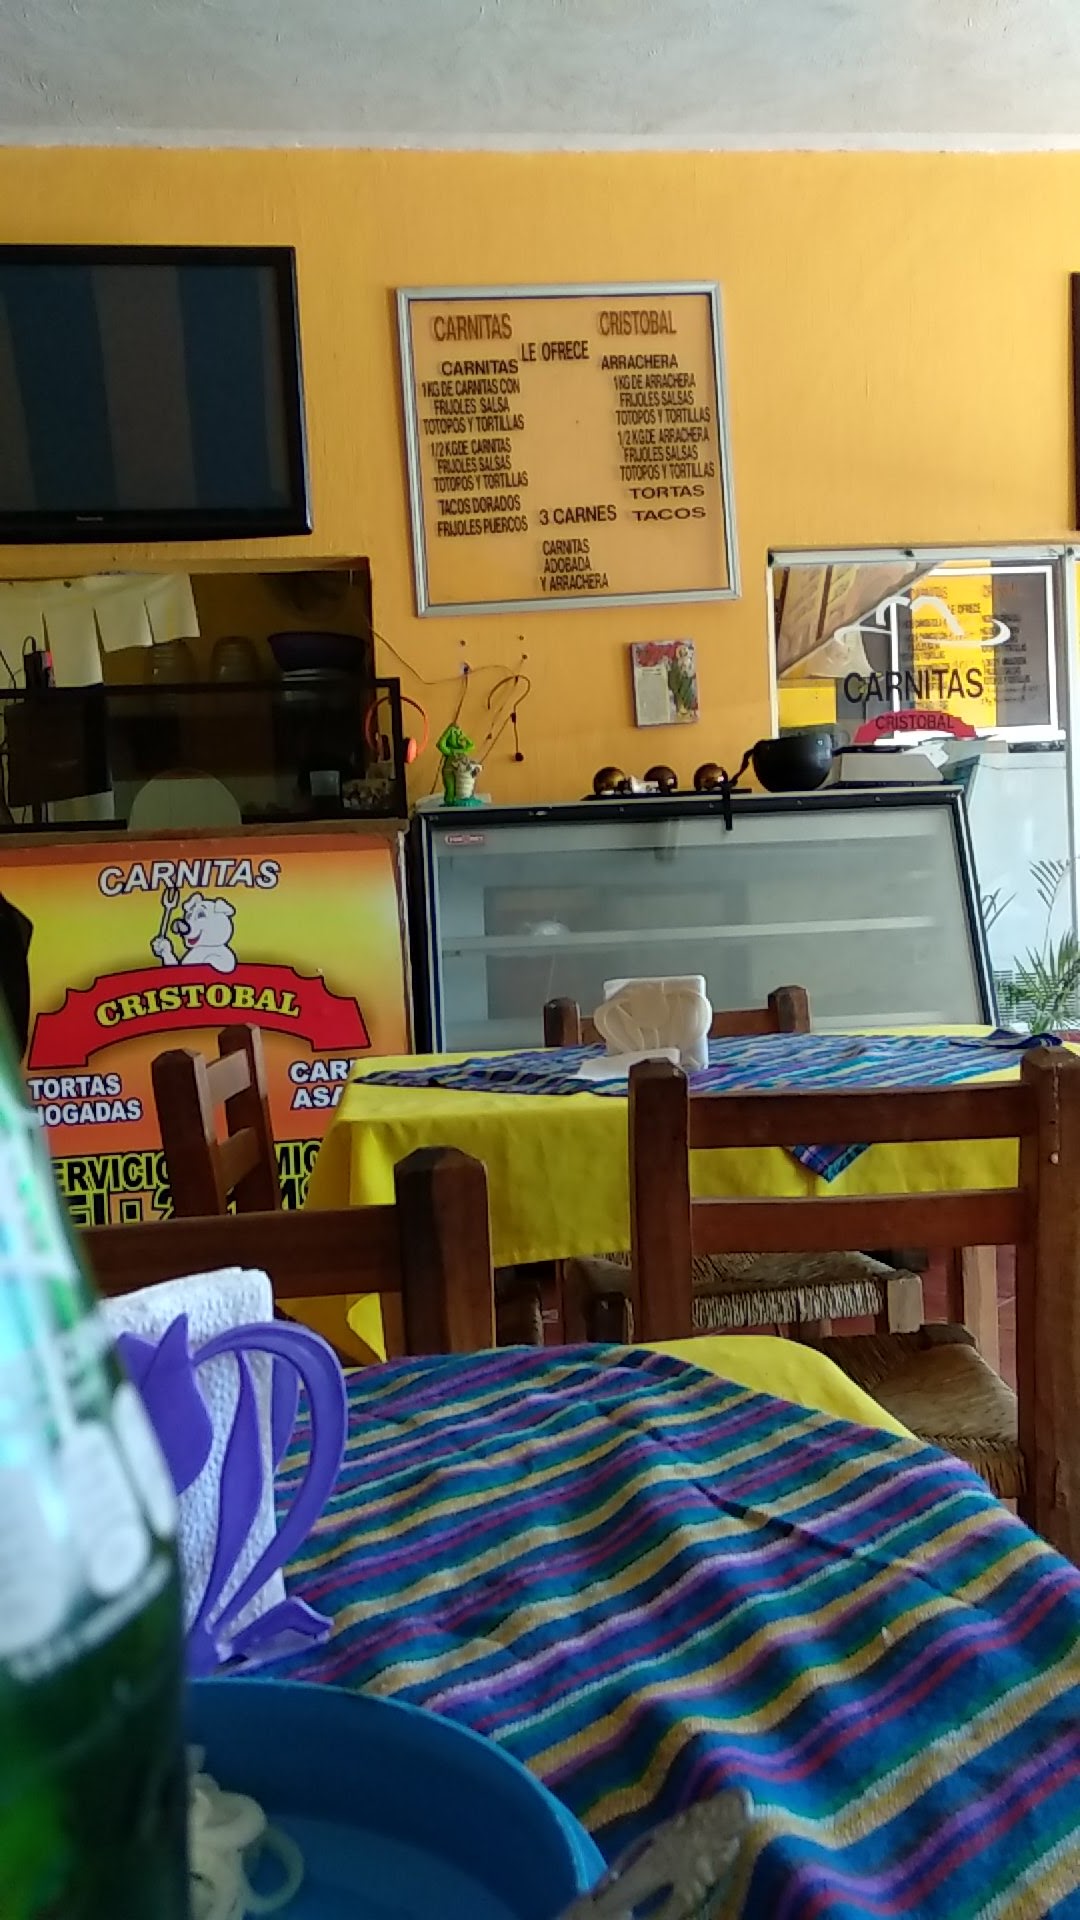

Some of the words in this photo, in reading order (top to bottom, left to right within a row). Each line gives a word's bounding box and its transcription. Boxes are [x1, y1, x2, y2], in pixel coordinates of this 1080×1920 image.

[433, 313, 512, 341] CARNITAS
[600, 310, 677, 336] CRISTOBAL
[521, 342, 536, 361] LE
[542, 340, 589, 361] OFRECE
[441, 358, 518, 376] CARNITAS
[601, 354, 678, 370] ARRACHERA
[455, 378, 498, 396] CARNITAS
[500, 377, 520, 394] CON
[645, 373, 696, 389] ARRACHERA
[434, 398, 476, 415] FRIJOLES
[480, 397, 510, 413] SALSA
[620, 391, 660, 407] FRIJOLES
[661, 390, 694, 406] SALSAS
[423, 416, 466, 435] TOTOPOS
[468, 416, 473, 432] Y
[475, 414, 524, 432] TORTILLAS
[615, 408, 655, 425] TOTOPOS
[658, 409, 663, 424] Y
[665, 407, 710, 423] TORTILLAS
[659, 427, 710, 443] ARRACHERA
[471, 437, 512, 455] CARNITAS
[623, 446, 663, 462] FRIJOLES
[665, 444, 698, 461] SALSAS
[437, 457, 476, 474] FRIJOLES
[479, 454, 511, 472] SALSAS
[620, 464, 660, 481] TOTOPOS
[662, 464, 668, 479] Y
[669, 461, 714, 479] TORTILLAS
[433, 475, 474, 493] TOTOPOS
[475, 476, 482, 490] Y
[483, 471, 528, 489] TORTILLAS
[629, 484, 705, 500] TORTAS
[439, 498, 471, 516] TACOS
[472, 494, 521, 514] DORADOS
[539, 509, 549, 525] 3
[553, 504, 617, 525] CARNES
[632, 506, 706, 521] TACOS
[437, 518, 482, 536] FRIJOLES
[484, 515, 528, 535] PUERCOS
[542, 538, 590, 556] CARNITAS
[543, 556, 592, 573] ADOBADA
[540, 576, 546, 591] Y
[550, 573, 609, 591] ARRACHERA
[843, 668, 983, 704] CARNITAS
[875, 714, 955, 731] CRISTOBAL
[99, 859, 281, 896] CARNITAS
[96, 984, 300, 1028] CRISTOBAL
[28, 1074, 121, 1100] TORTAS
[51, 1152, 169, 1192] ERVICIO
